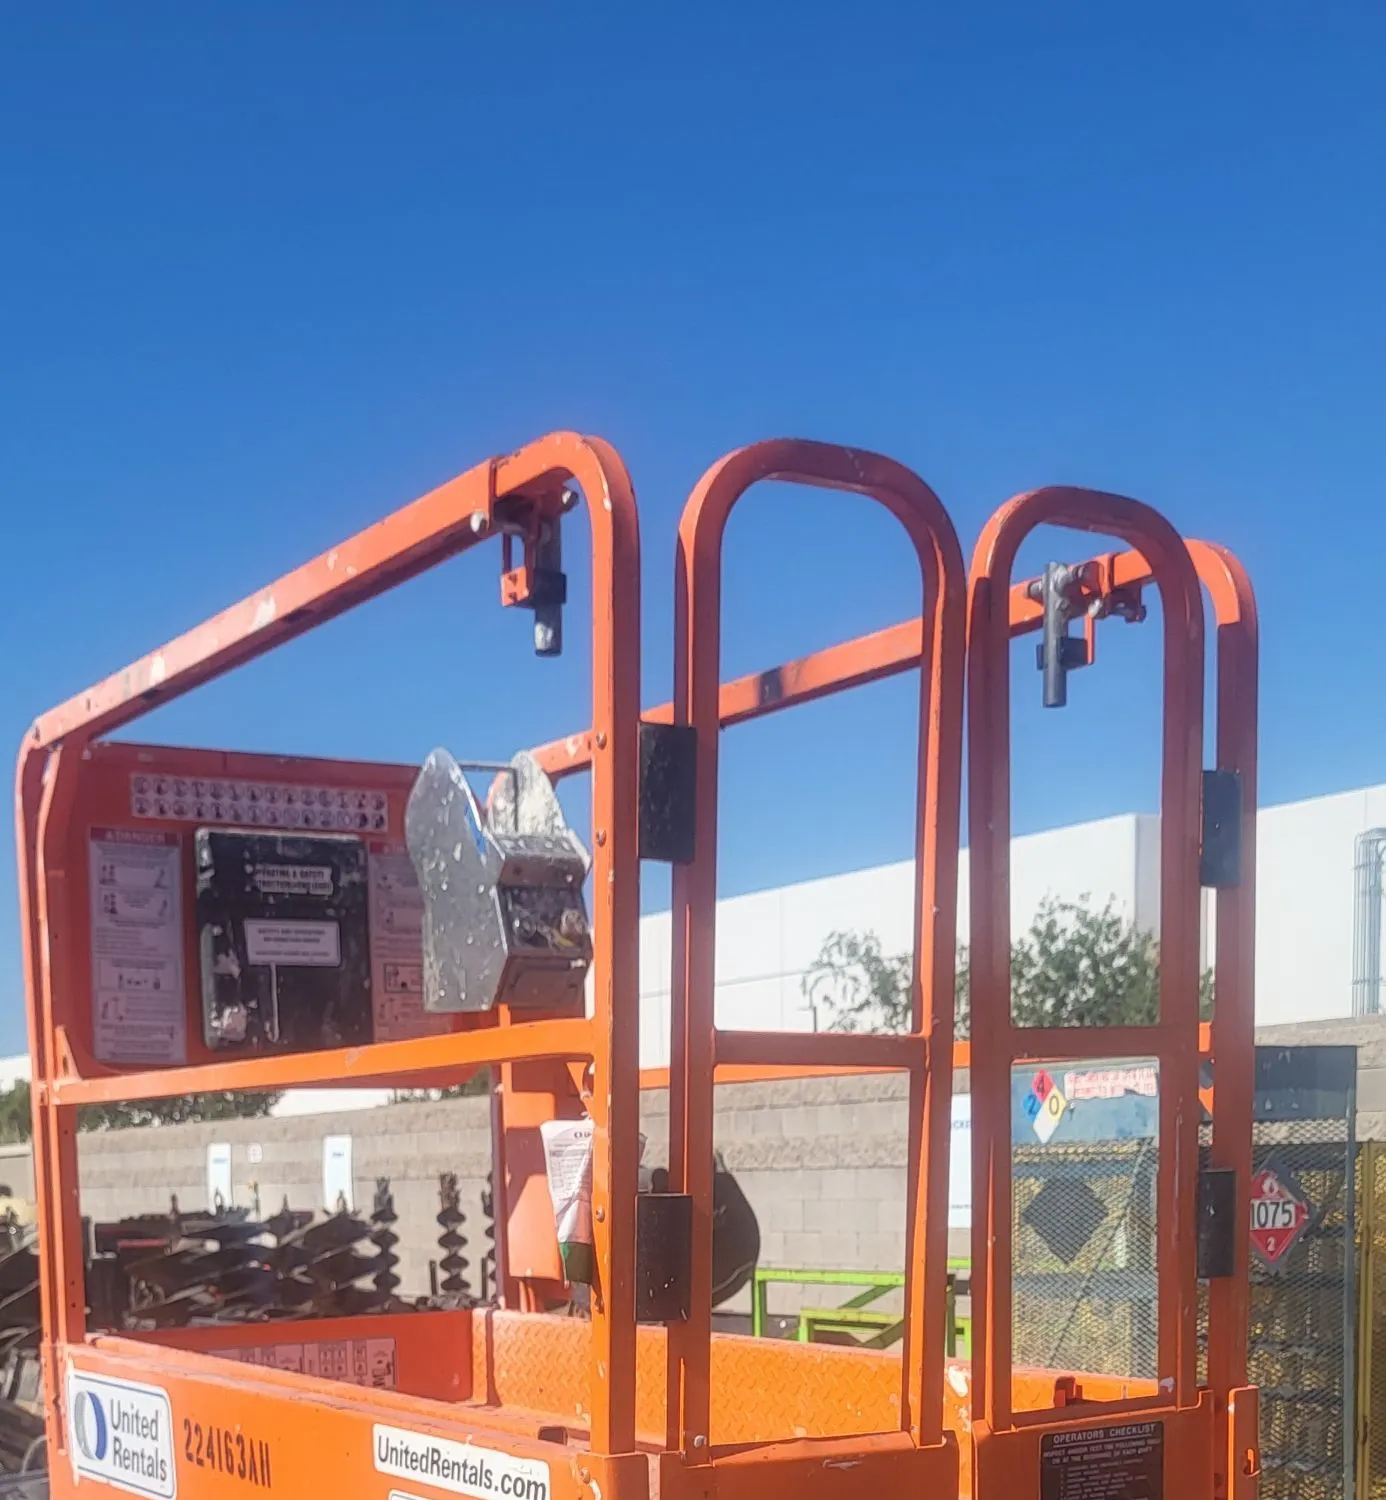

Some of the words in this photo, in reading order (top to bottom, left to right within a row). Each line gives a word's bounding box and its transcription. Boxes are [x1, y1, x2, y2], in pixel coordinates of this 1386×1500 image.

[1027, 1094, 1038, 1116] 2
[1049, 1095, 1059, 1115] 0
[1251, 1200, 1293, 1229] 1075
[1266, 1236, 1276, 1252] 2
[110, 1399, 159, 1442] United
[1053, 1430, 1104, 1444] OPERATORS
[1109, 1424, 1156, 1437] CHECKLIST
[113, 1438, 168, 1483] Rentals
